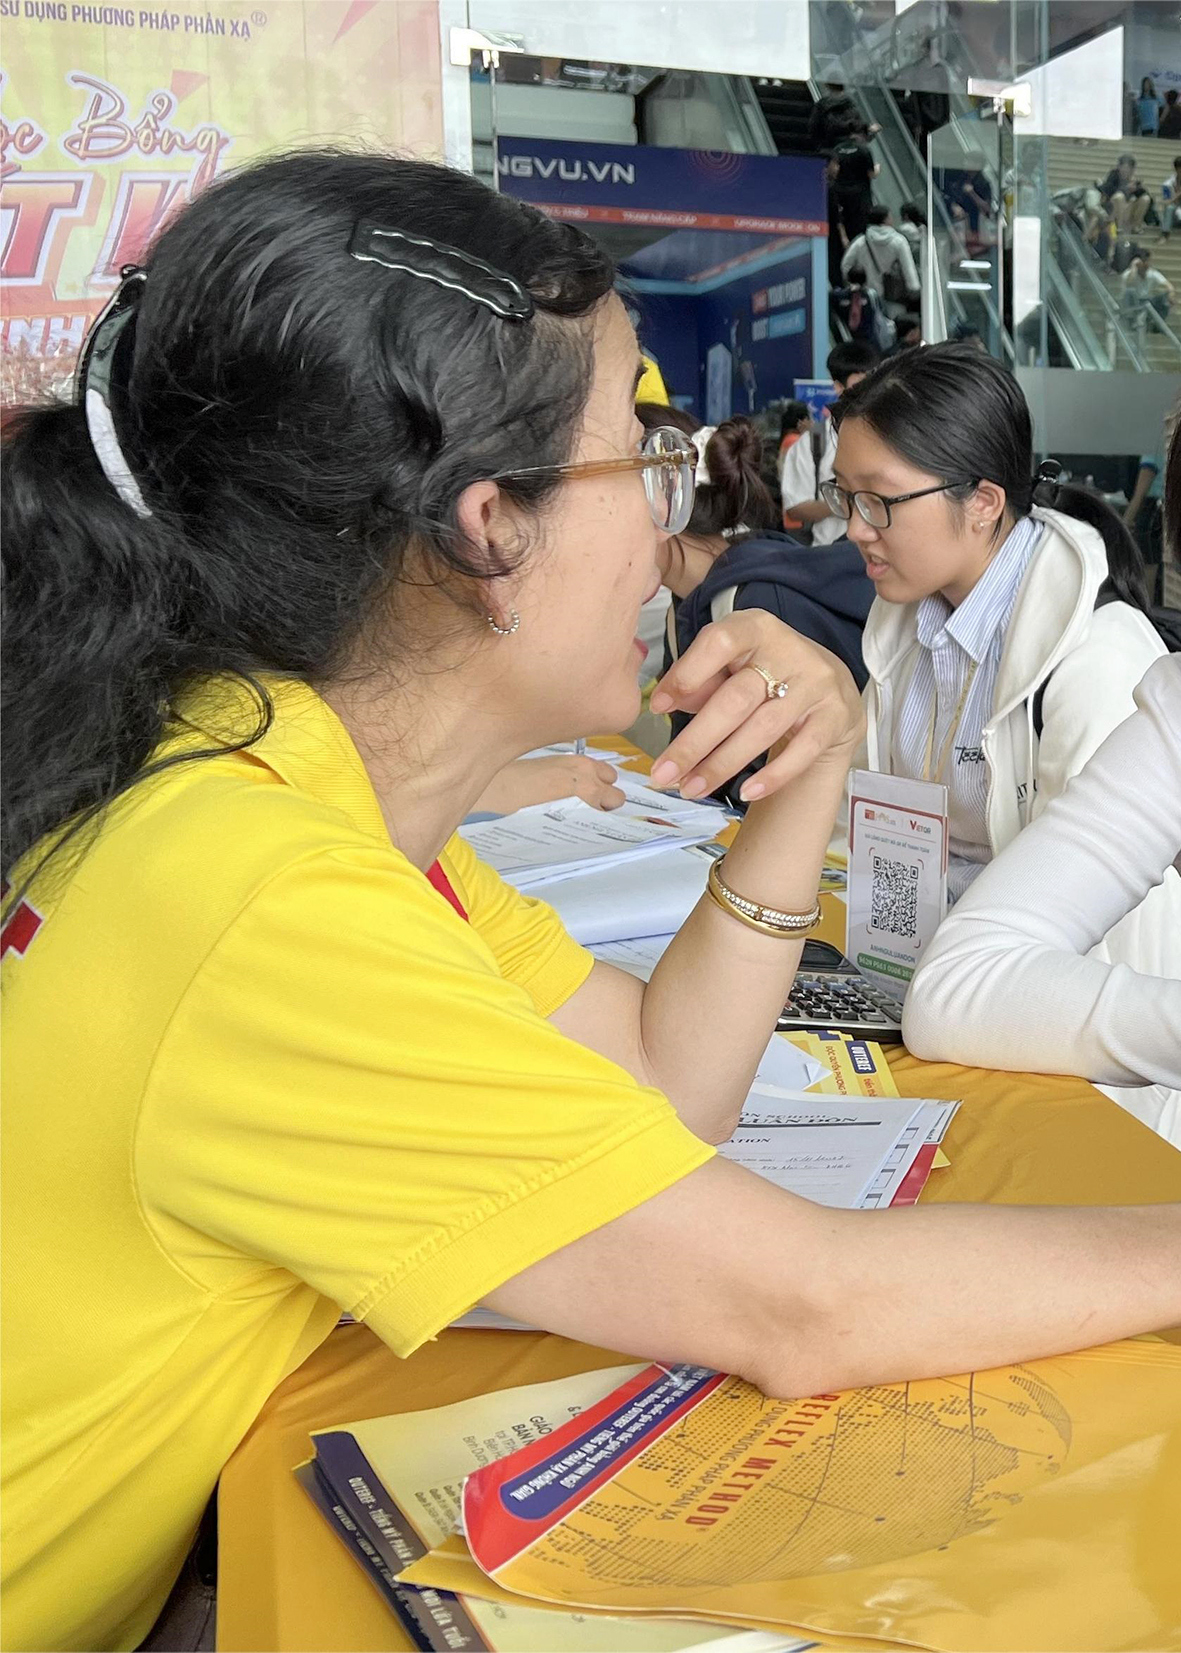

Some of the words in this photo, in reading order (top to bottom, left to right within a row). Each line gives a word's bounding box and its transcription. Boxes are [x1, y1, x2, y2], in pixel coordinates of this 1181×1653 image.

[24, 0, 67, 22] DỤNG
[72, 5, 135, 27] PHƯƠNG
[140, 9, 180, 31] PHÁP
[185, 12, 226, 36] PHẢN
[64, 75, 229, 200] Bổng
[850, 1046, 872, 1071] OUTEREF
[511, 1424, 530, 1441] BẢN
[530, 1415, 553, 1436] GIÁO
[719, 1427, 765, 1463] PHƯƠNG
[701, 1462, 730, 1485] PHÁP
[671, 1484, 707, 1509] PHẢN
[685, 1456, 778, 1527] METHOD
[655, 1508, 682, 1522] XẠ
